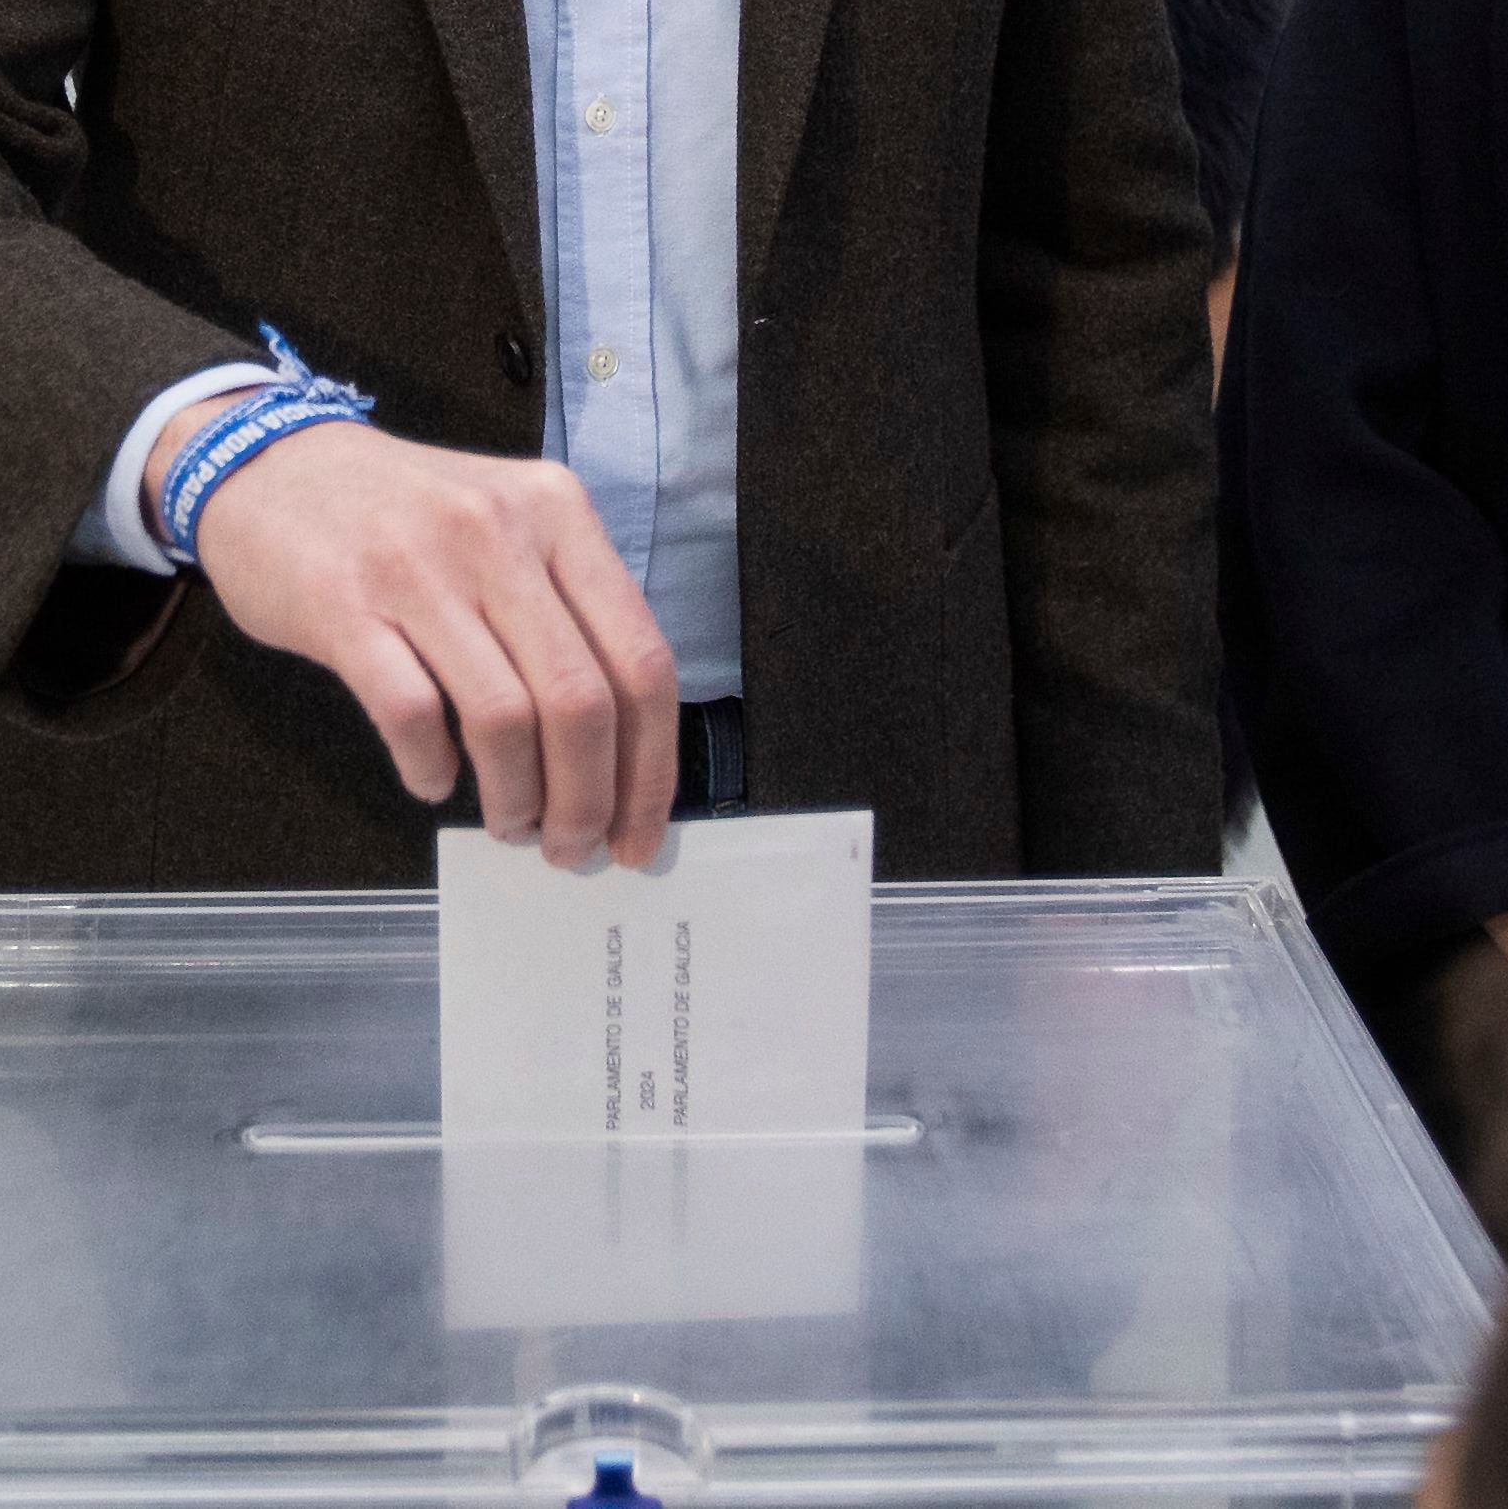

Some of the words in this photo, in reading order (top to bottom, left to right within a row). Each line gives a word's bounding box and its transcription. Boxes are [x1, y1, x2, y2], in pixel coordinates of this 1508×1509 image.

[607, 923, 623, 988] GALICIA
[675, 920, 691, 985] GALICIA
[606, 994, 623, 1019] DE
[675, 991, 691, 1014] DE
[605, 1023, 622, 1130] PARLAMENTO
[640, 1070, 656, 1111] 2024
[673, 1015, 690, 1128] PARLAMENTO
